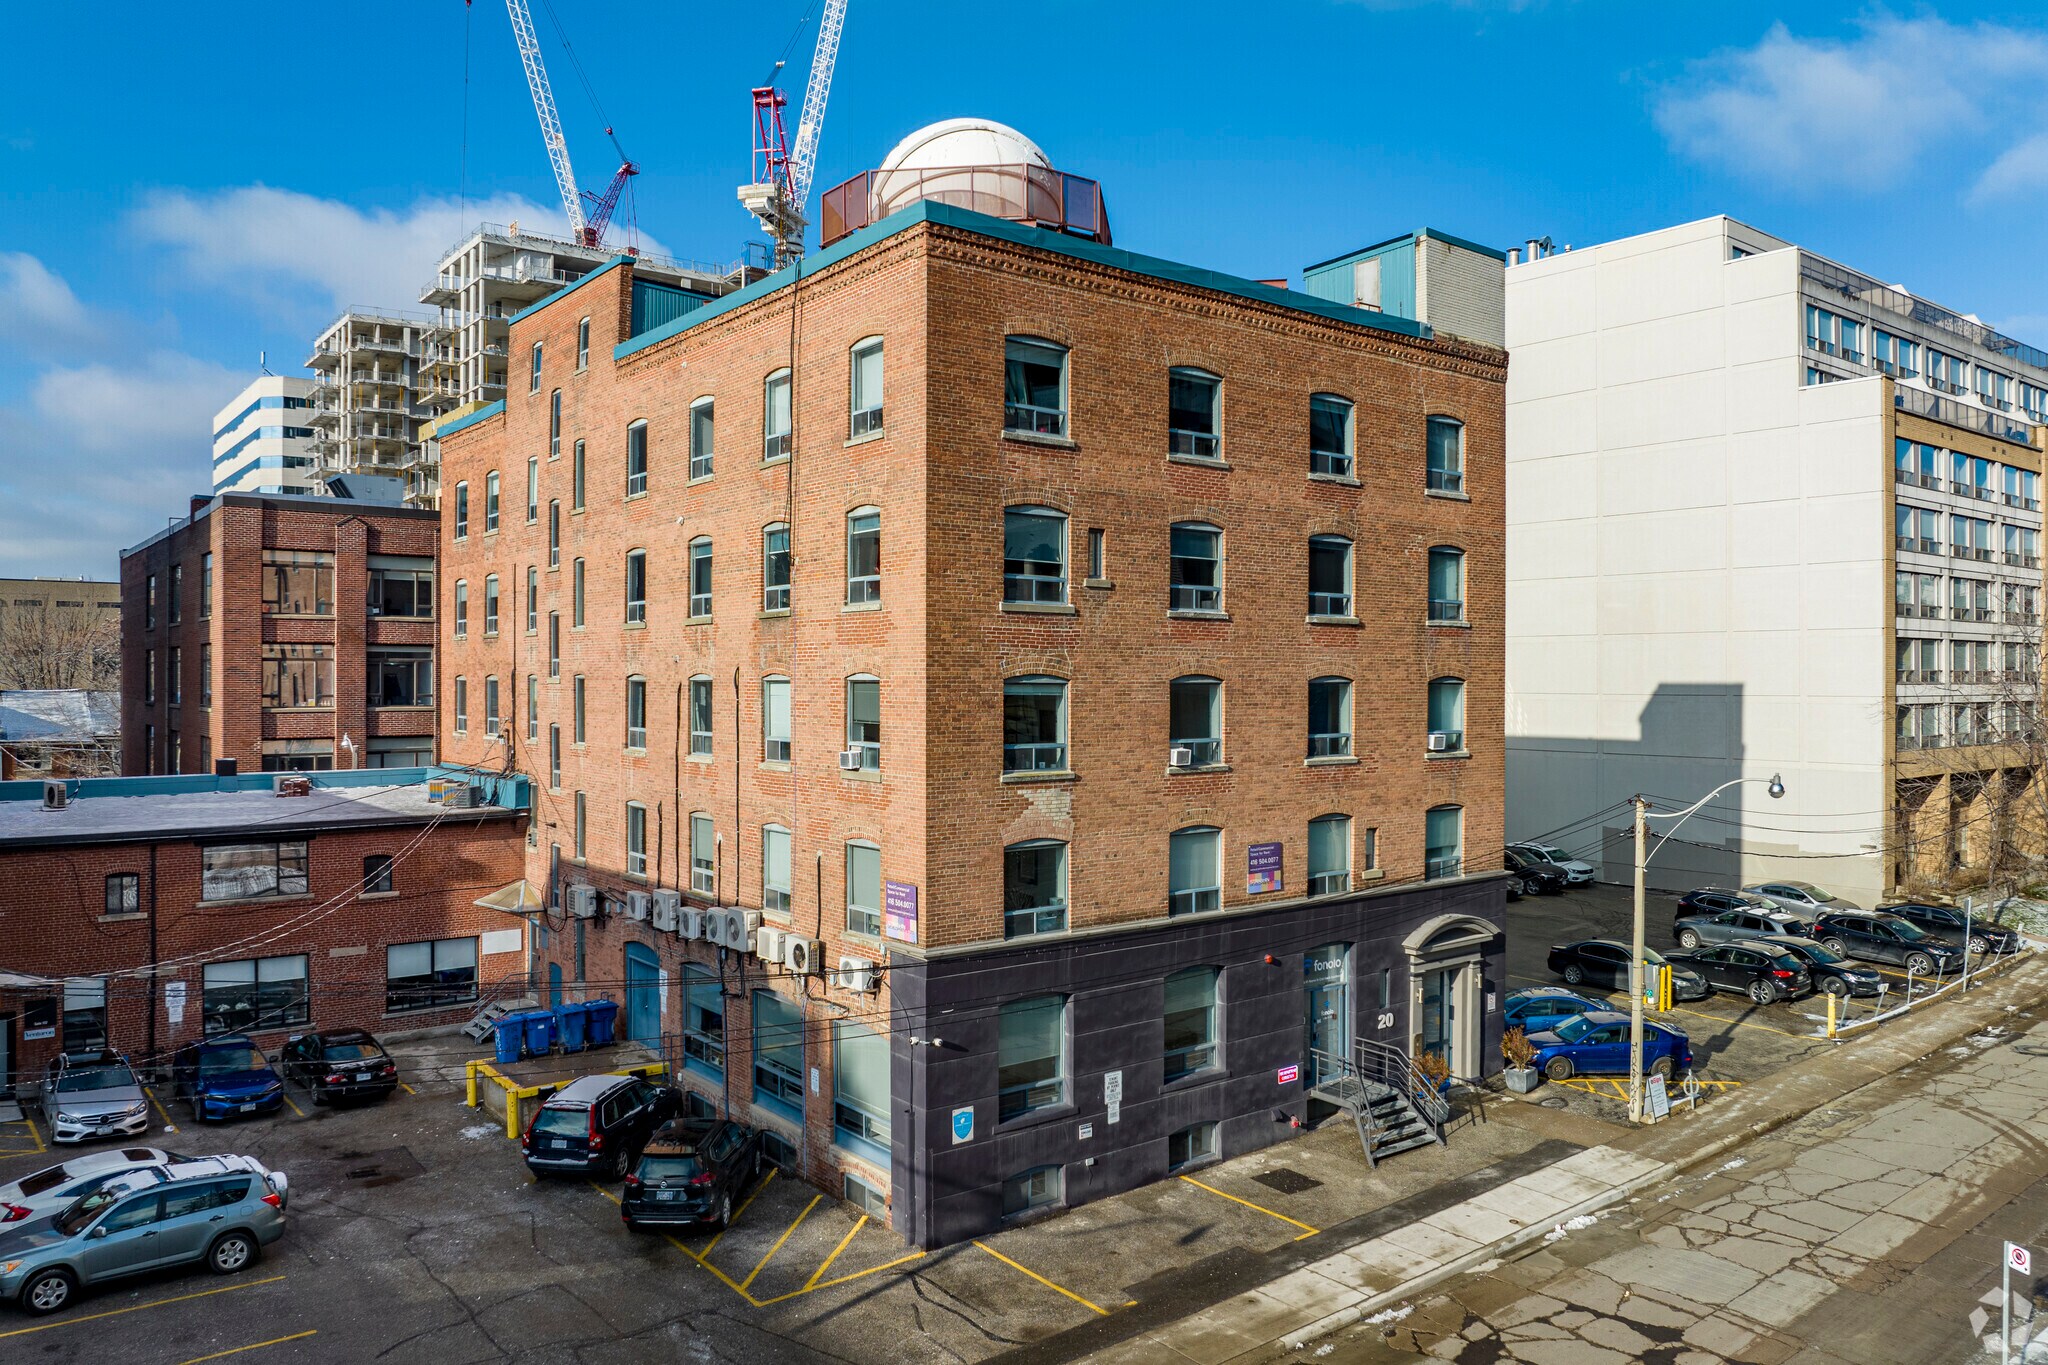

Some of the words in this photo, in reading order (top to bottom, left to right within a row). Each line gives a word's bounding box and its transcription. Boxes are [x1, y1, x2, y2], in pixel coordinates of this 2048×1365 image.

[1259, 856, 1279, 865] 504.0077
[895, 898, 914, 909] 504.0077
[1314, 958, 1341, 972] fonolo
[1321, 1008, 1335, 1017] fonolo
[1377, 1012, 1395, 1030] 20
